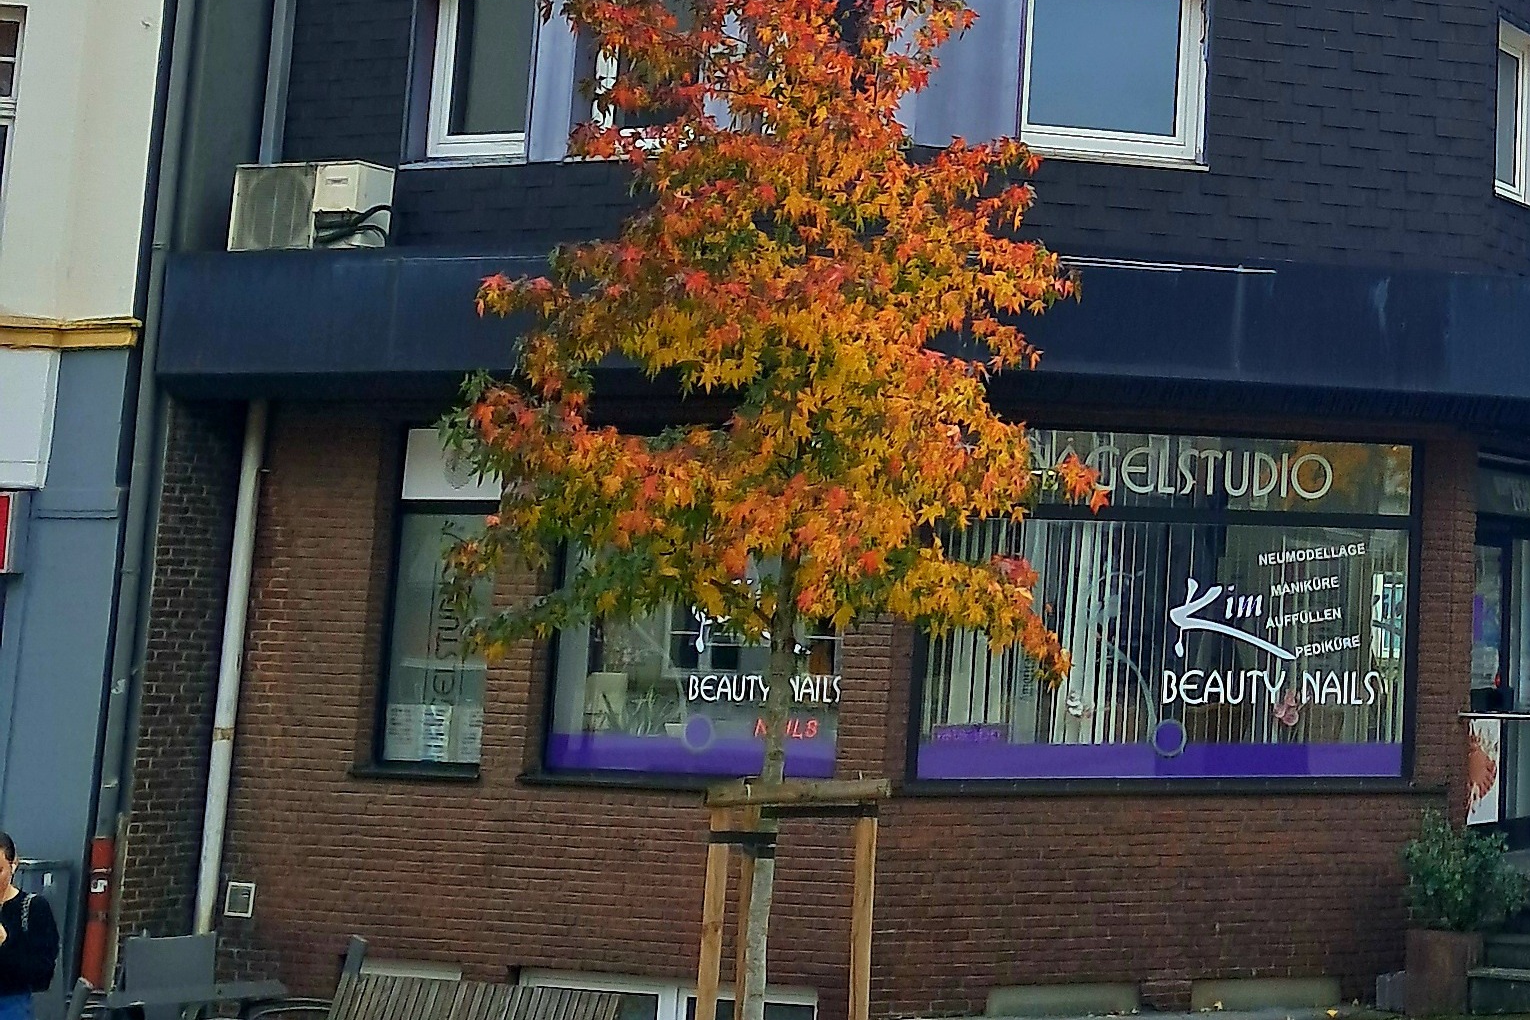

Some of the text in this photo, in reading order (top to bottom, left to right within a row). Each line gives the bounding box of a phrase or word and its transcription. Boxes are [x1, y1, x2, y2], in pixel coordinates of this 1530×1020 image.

[1258, 542, 1367, 567] NEUMODELLAGE
[1270, 575, 1340, 597] MANIKÜRE
[1265, 606, 1342, 630] AUFFÜLLEN
[1295, 633, 1362, 658] PEDIKÜRE
[688, 674, 771, 702] BEAUTY
[1161, 669, 1380, 705] BEAUTY NAILS
[754, 718, 819, 739] NILS
